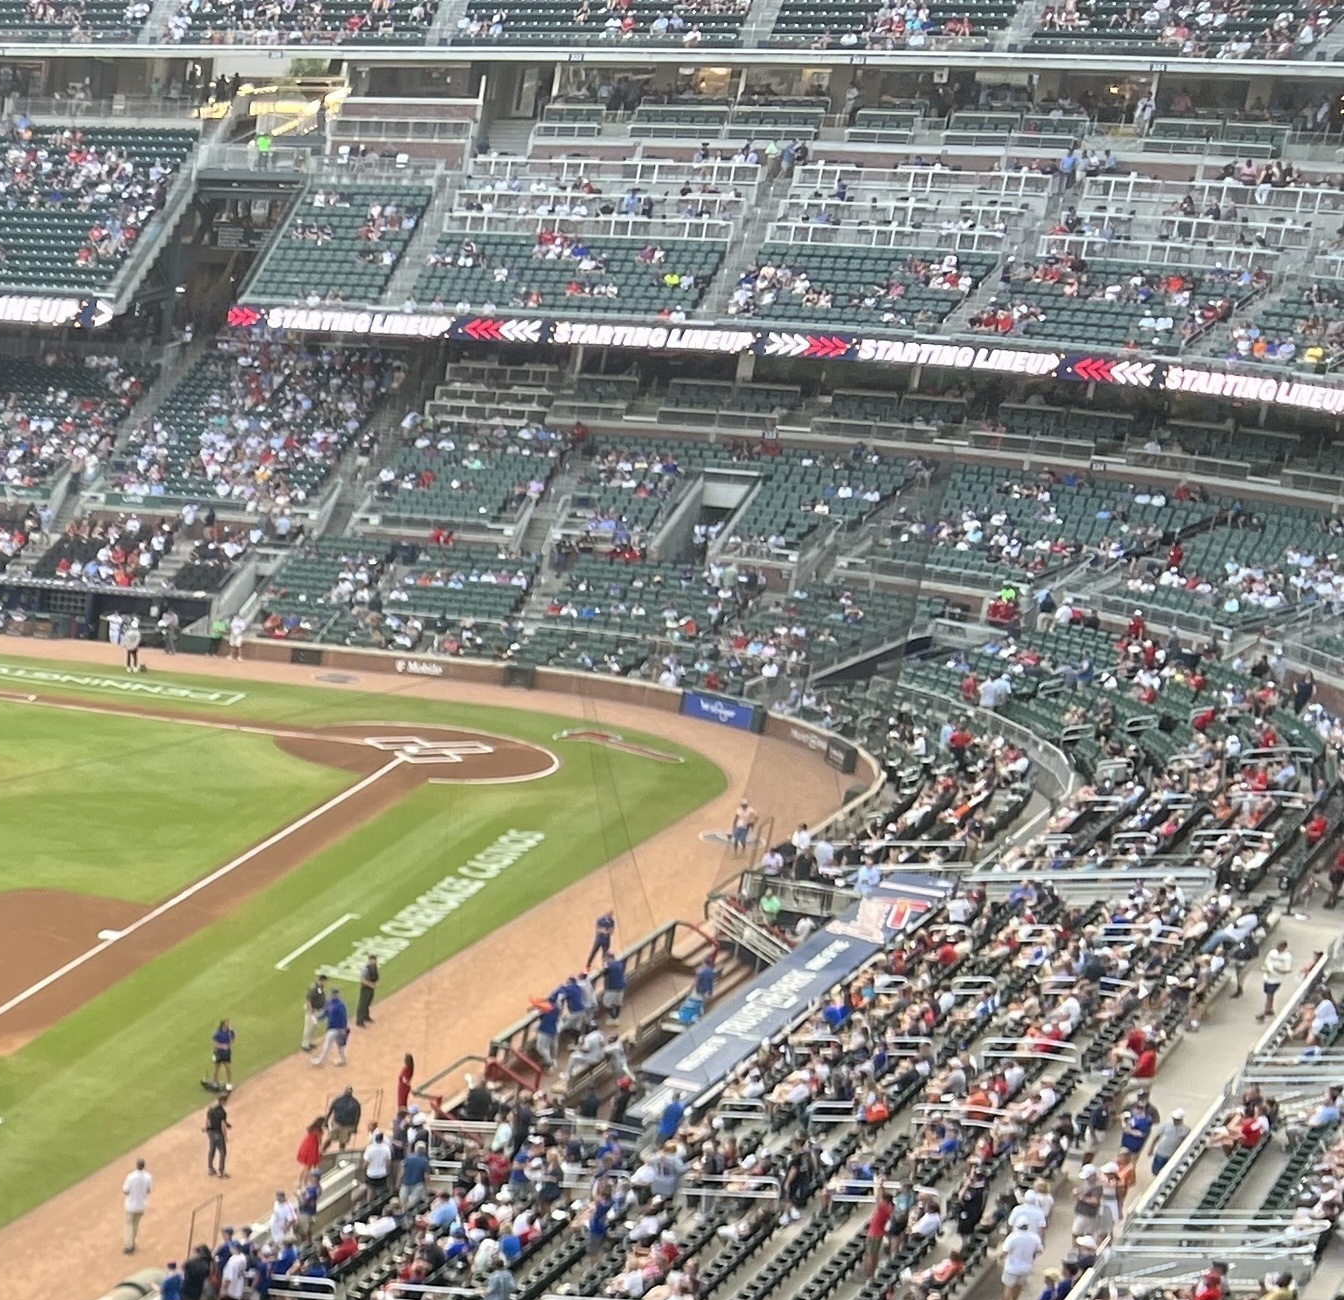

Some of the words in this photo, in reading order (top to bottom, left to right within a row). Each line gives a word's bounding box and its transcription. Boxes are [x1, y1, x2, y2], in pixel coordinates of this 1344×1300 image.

[267, 308, 370, 334] STARTING
[370, 313, 451, 337] LINEUP
[554, 324, 665, 347] STARTING
[665, 330, 754, 352] LINEUP
[857, 340, 974, 366] STARTING
[972, 348, 1059, 374] LINEUP
[1166, 369, 1279, 400] STARTING
